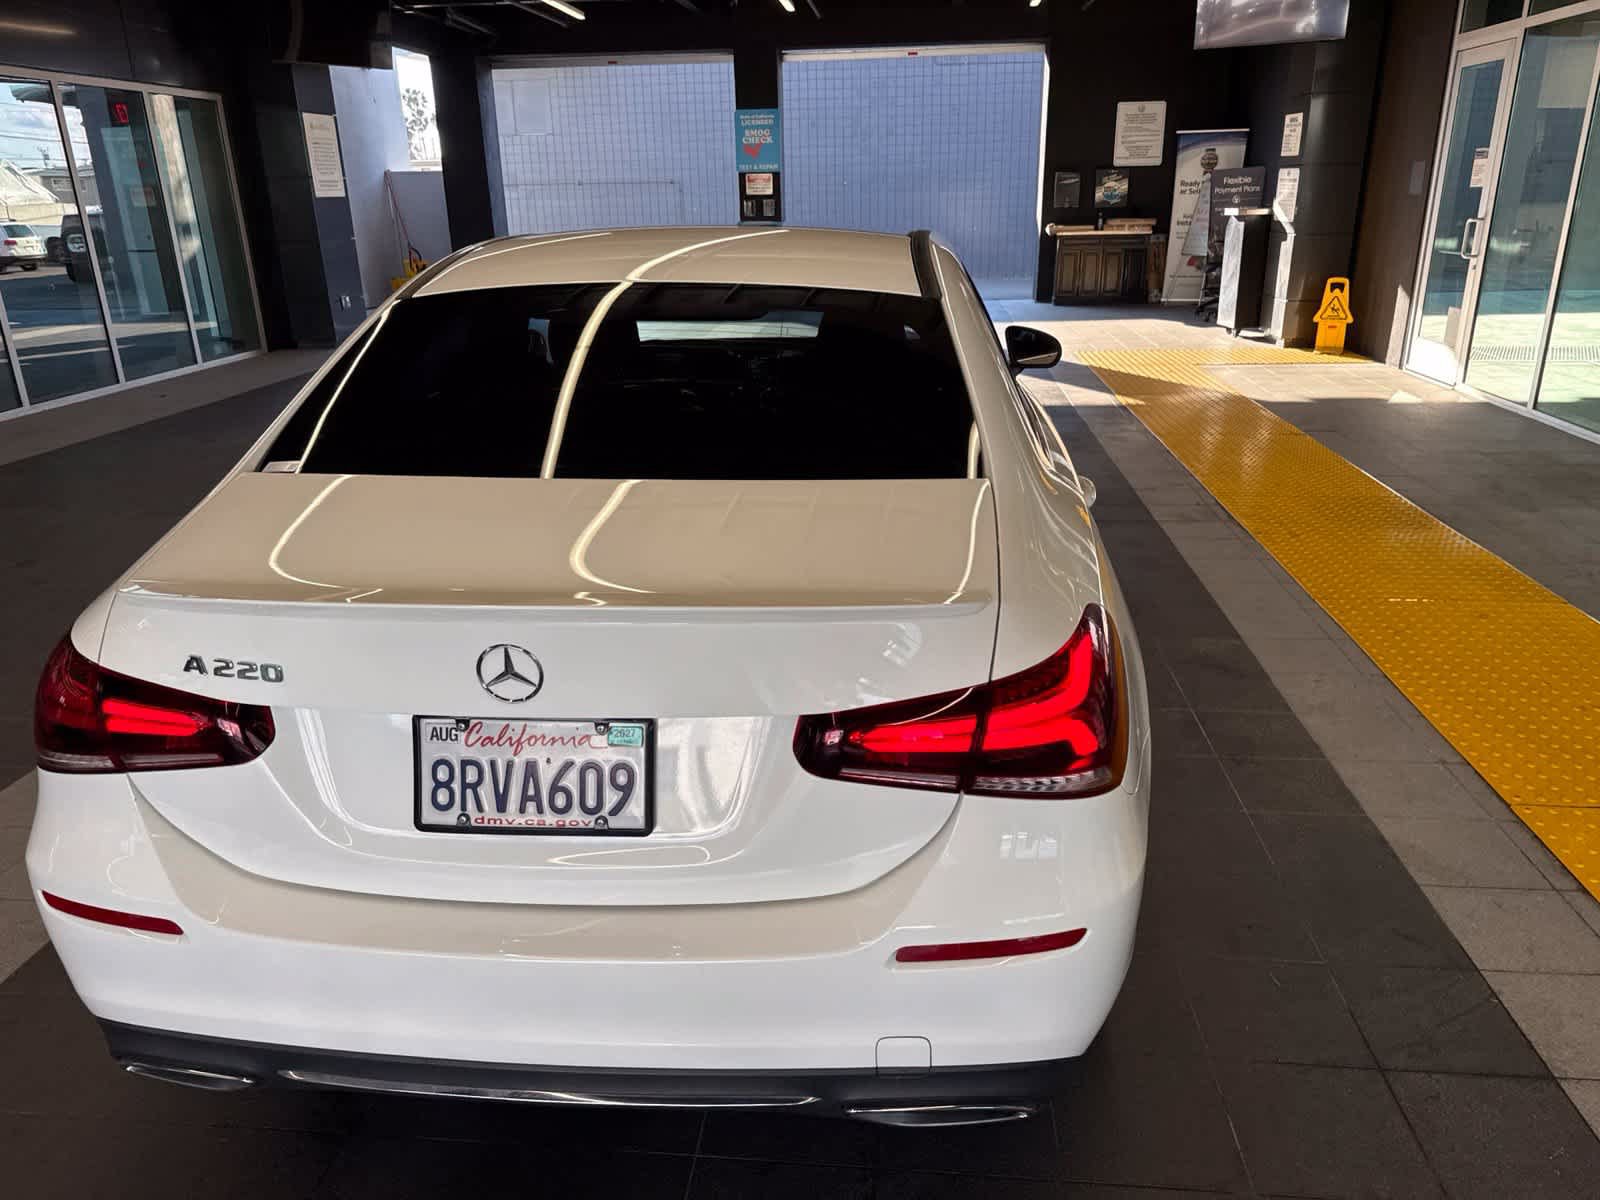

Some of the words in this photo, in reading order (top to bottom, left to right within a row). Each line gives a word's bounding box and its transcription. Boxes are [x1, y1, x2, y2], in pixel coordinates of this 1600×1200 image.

[744, 129, 770, 137] SMOG
[1223, 176, 1252, 185] Flexible
[1215, 187, 1242, 195] Payment
[1243, 185, 1261, 193] Plans
[183, 655, 208, 675] A
[213, 658, 284, 683] 220
[430, 726, 459, 742] AUG
[464, 721, 595, 756] California
[431, 757, 638, 817] 8RVA609
[474, 815, 592, 828] dmv.ca.gov
